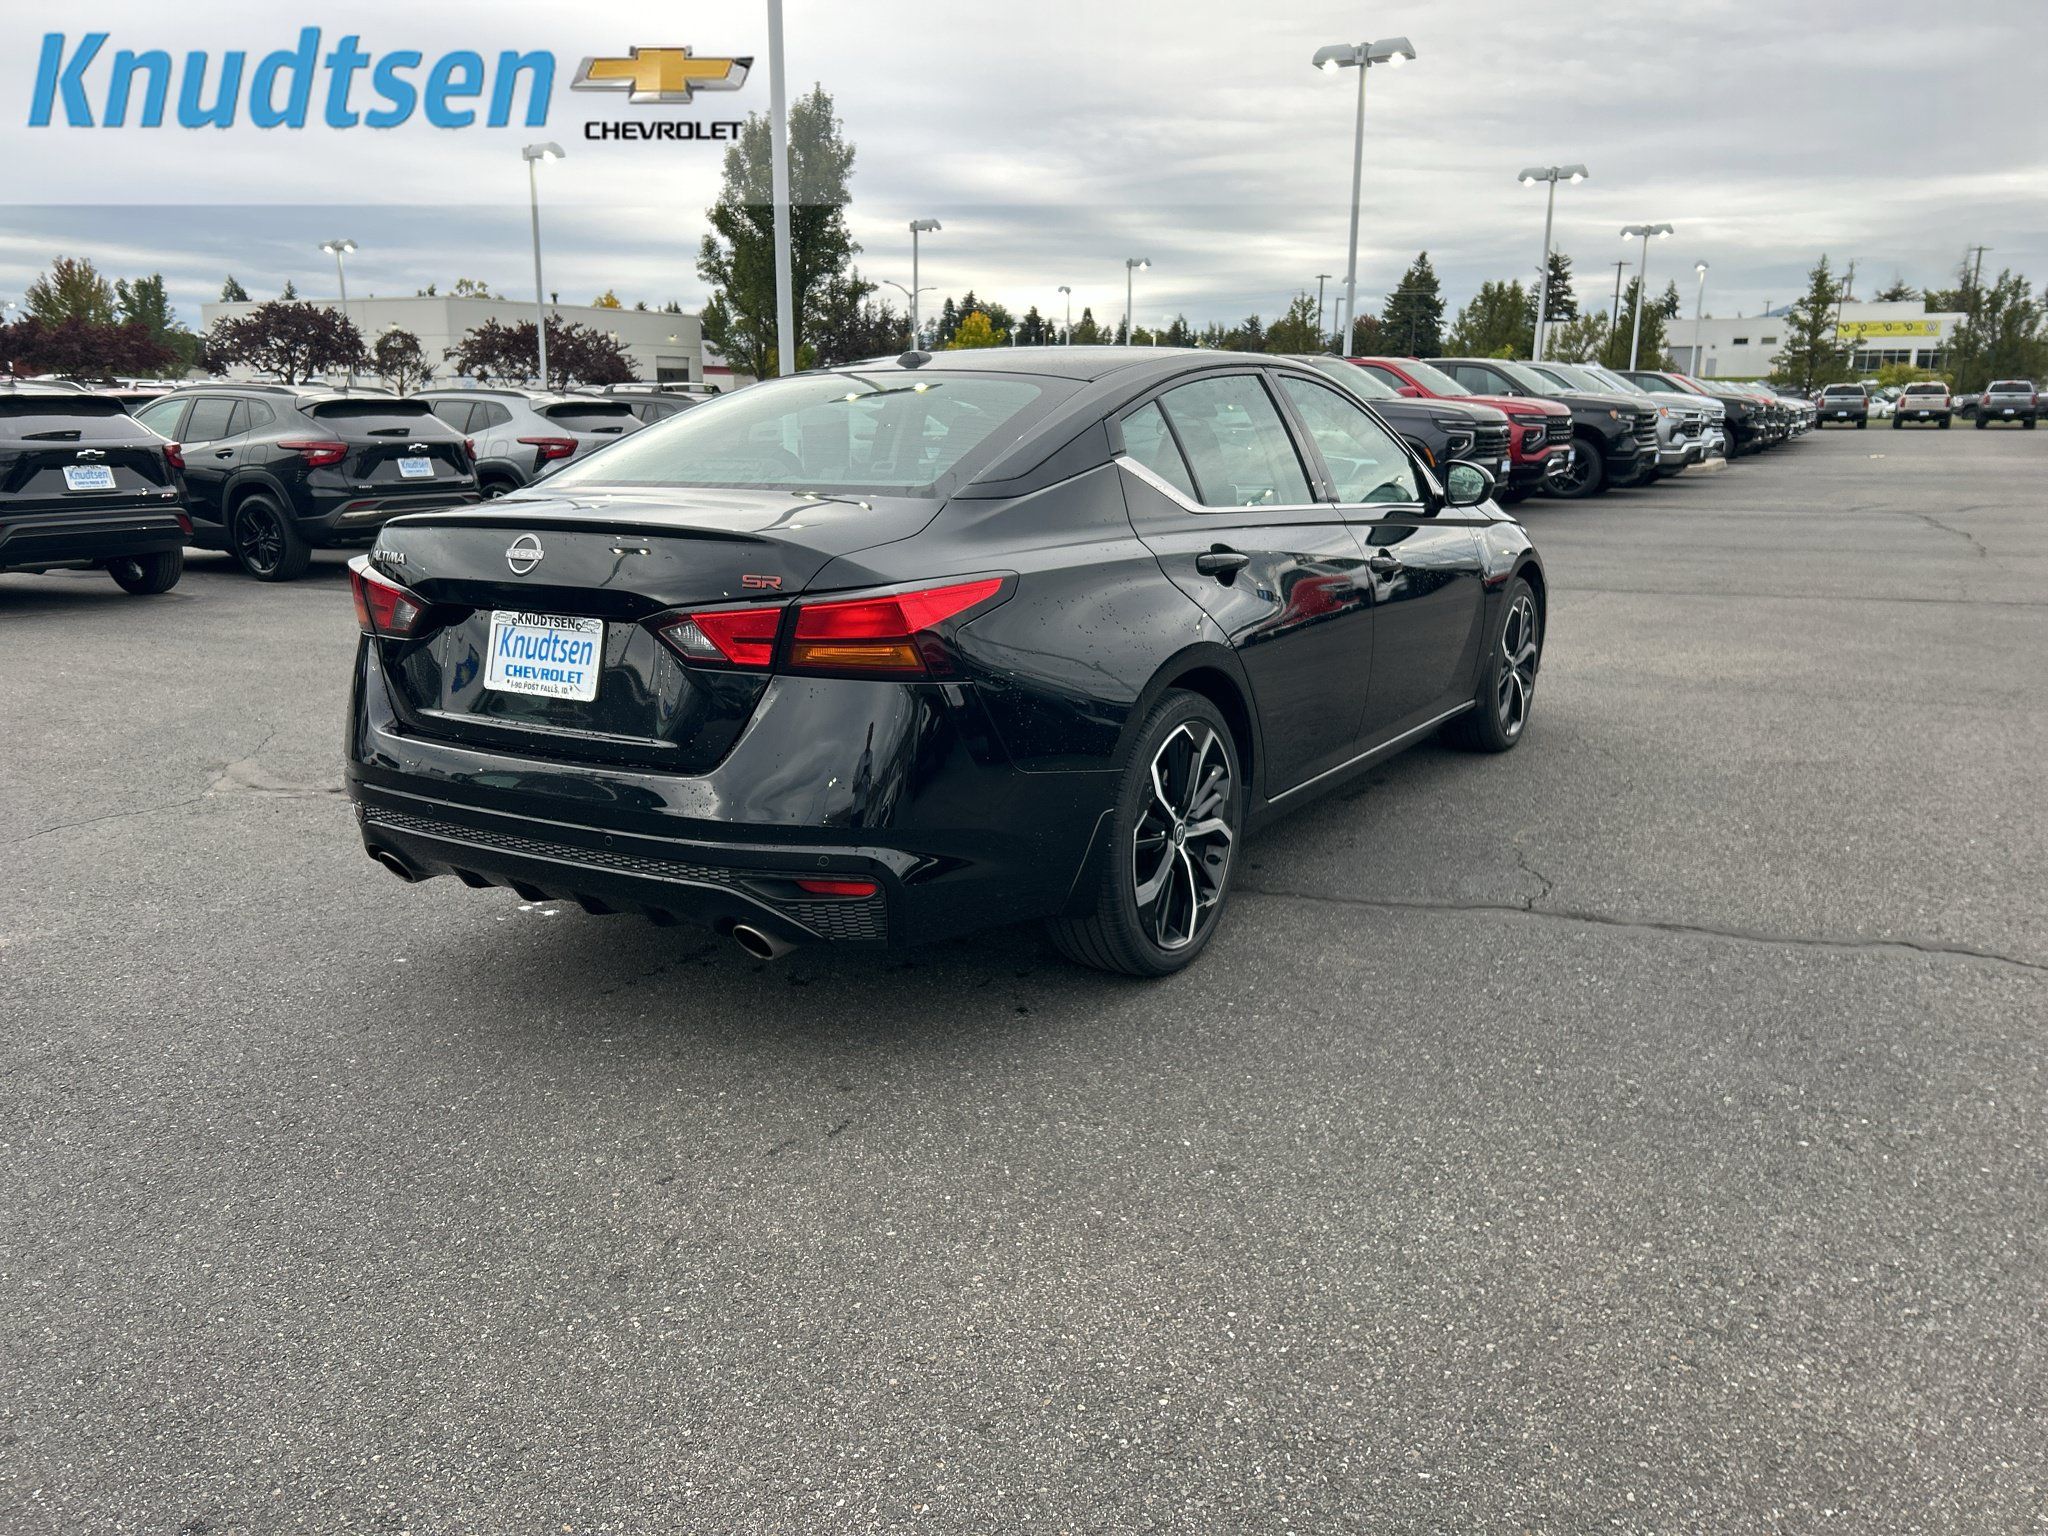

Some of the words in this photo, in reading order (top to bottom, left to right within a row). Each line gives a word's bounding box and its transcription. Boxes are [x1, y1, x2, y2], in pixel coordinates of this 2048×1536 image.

[374, 550, 407, 565] ALTIMA
[506, 550, 543, 560] NISSAN
[742, 574, 782, 590] SR
[517, 613, 576, 630] KNUDTSEN
[499, 626, 593, 665] Knudtsen
[505, 664, 583, 684] CHEVROLET
[523, 681, 539, 691] POST
